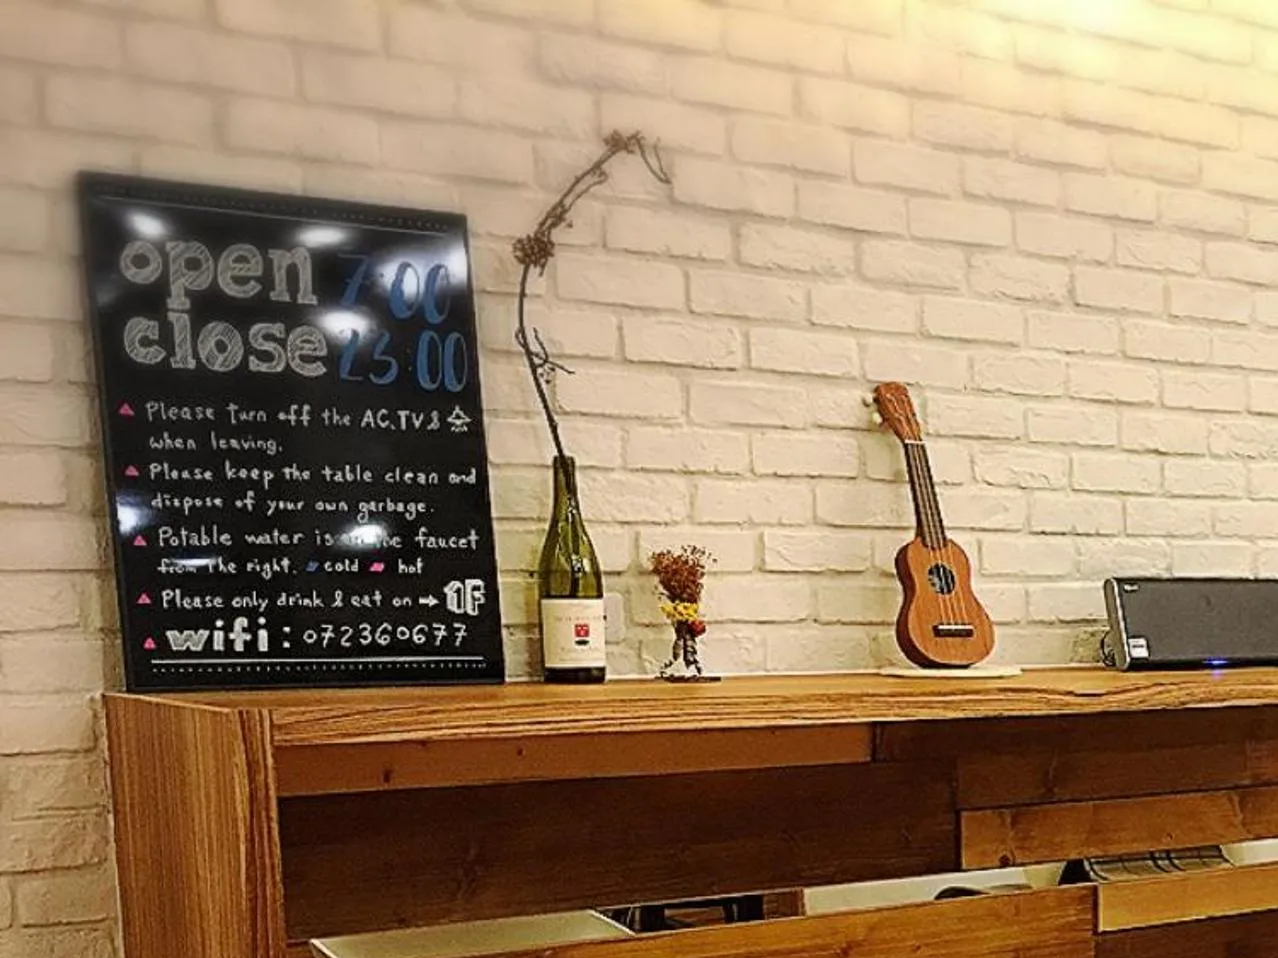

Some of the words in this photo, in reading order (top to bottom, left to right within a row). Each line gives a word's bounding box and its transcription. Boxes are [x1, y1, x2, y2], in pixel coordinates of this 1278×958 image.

[119, 240, 318, 309] open
[123, 312, 328, 377] close
[145, 401, 215, 422] Please
[226, 403, 267, 424] turn
[278, 404, 311, 426] off
[321, 407, 351, 426] the
[150, 431, 197, 449] when
[150, 462, 214, 481] Please
[225, 459, 274, 489] keep
[282, 463, 311, 481] the
[321, 464, 373, 482] table
[384, 466, 438, 485] clean
[448, 467, 476, 485] and
[151, 492, 223, 516] dispose
[235, 490, 256, 512] of
[266, 499, 305, 517] your
[315, 500, 348, 512] own
[158, 525, 233, 547] Potable
[245, 528, 305, 545] water
[315, 529, 335, 546] is
[415, 527, 479, 549] faucet
[324, 558, 359, 572] cold
[398, 557, 424, 574] hot
[161, 588, 225, 609] Please
[232, 590, 269, 612] only
[277, 589, 325, 608] drink
[351, 590, 383, 607] eat
[392, 597, 412, 607] on
[303, 622, 468, 648] 072360677
